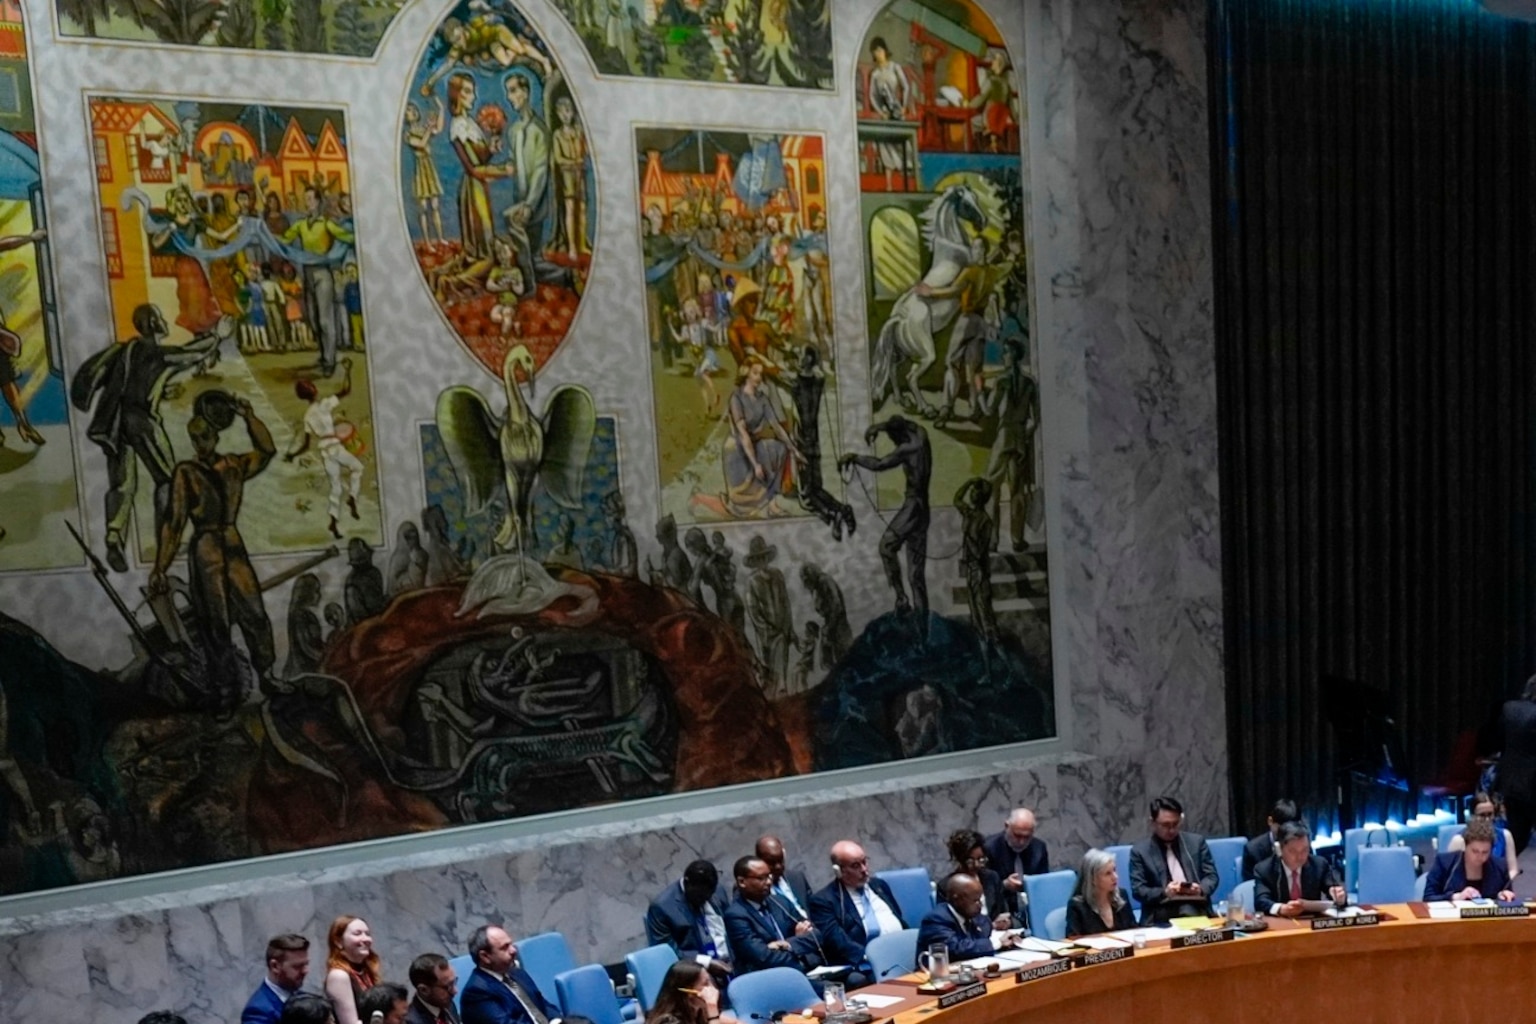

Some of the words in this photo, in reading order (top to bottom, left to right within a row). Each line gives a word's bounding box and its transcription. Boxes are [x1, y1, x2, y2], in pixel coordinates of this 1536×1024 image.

[1491, 906, 1528, 915] FEDERATION
[1314, 919, 1343, 928] REPUBLIC
[1345, 917, 1353, 925] OF
[1356, 915, 1377, 924] KOREA
[1184, 932, 1223, 945] DIRECTOR
[1084, 948, 1125, 964] PRESIDENT
[1020, 960, 1068, 981] MOZAMBIQUE
